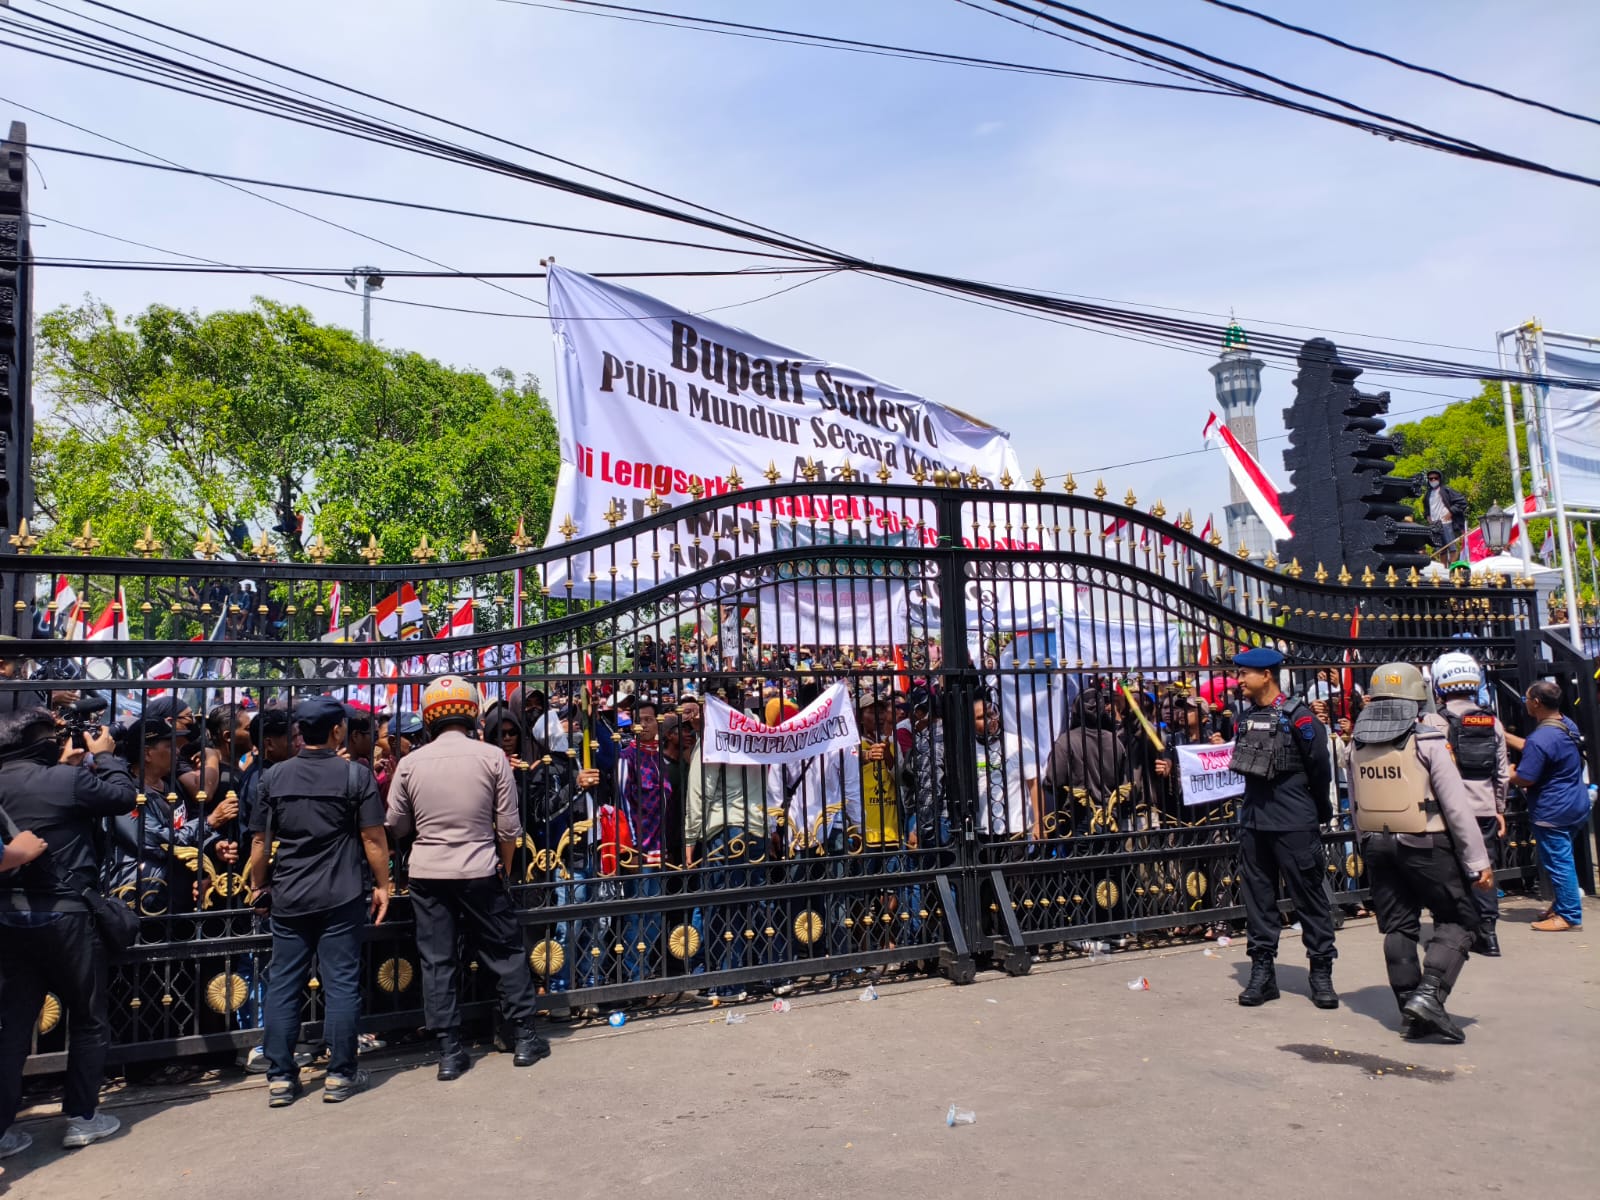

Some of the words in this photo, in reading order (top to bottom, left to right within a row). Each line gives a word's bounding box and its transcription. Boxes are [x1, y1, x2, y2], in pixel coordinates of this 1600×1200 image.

[670, 320, 805, 405] Bupati
[600, 350, 679, 412] Pilih
[687, 382, 800, 445] Mundur
[810, 416, 899, 469] Secara
[601, 451, 762, 512] Lengserk
[425, 687, 470, 705] POLISI
[1464, 716, 1492, 725] POLISI
[1360, 766, 1402, 780] POLISI
